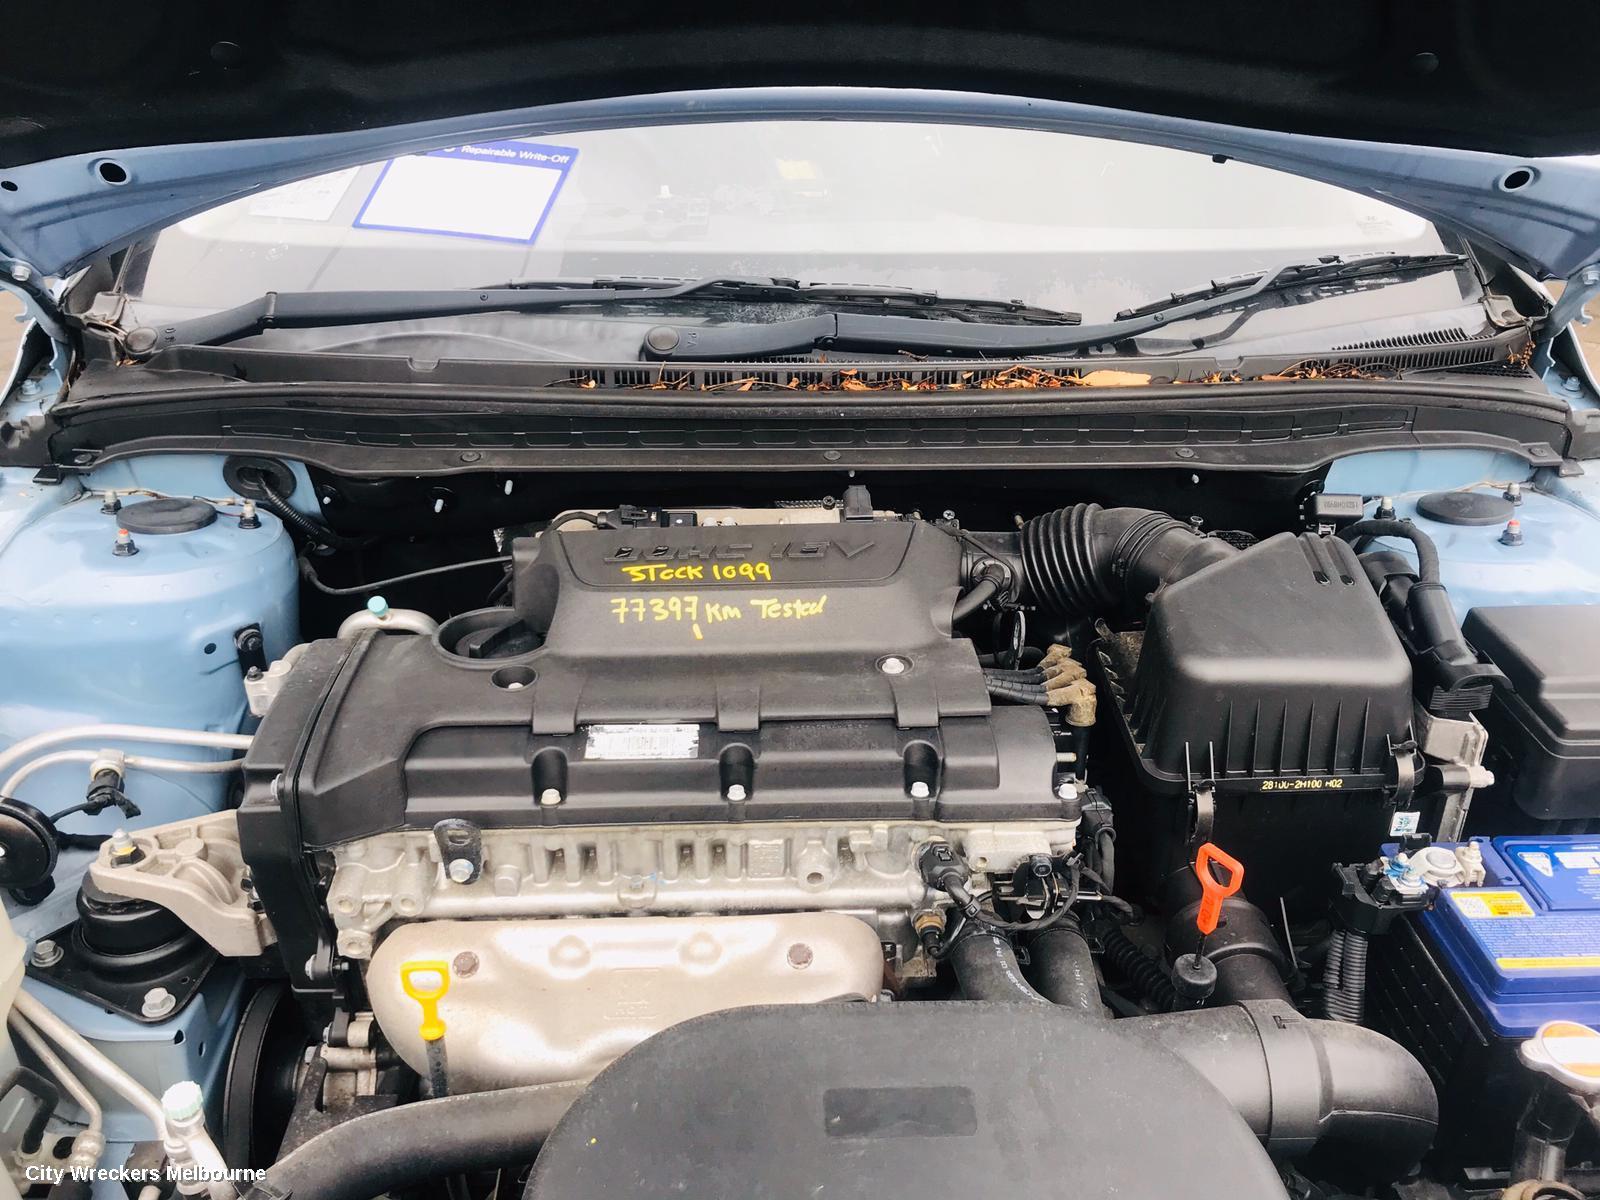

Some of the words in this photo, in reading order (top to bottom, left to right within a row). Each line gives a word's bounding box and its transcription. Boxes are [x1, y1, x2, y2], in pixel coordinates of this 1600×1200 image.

[461, 145, 517, 158] Repairable
[519, 150, 570, 164] Write-Off
[712, 562, 772, 581] 1099
[610, 596, 699, 624] 77397
[750, 595, 828, 620] Tested
